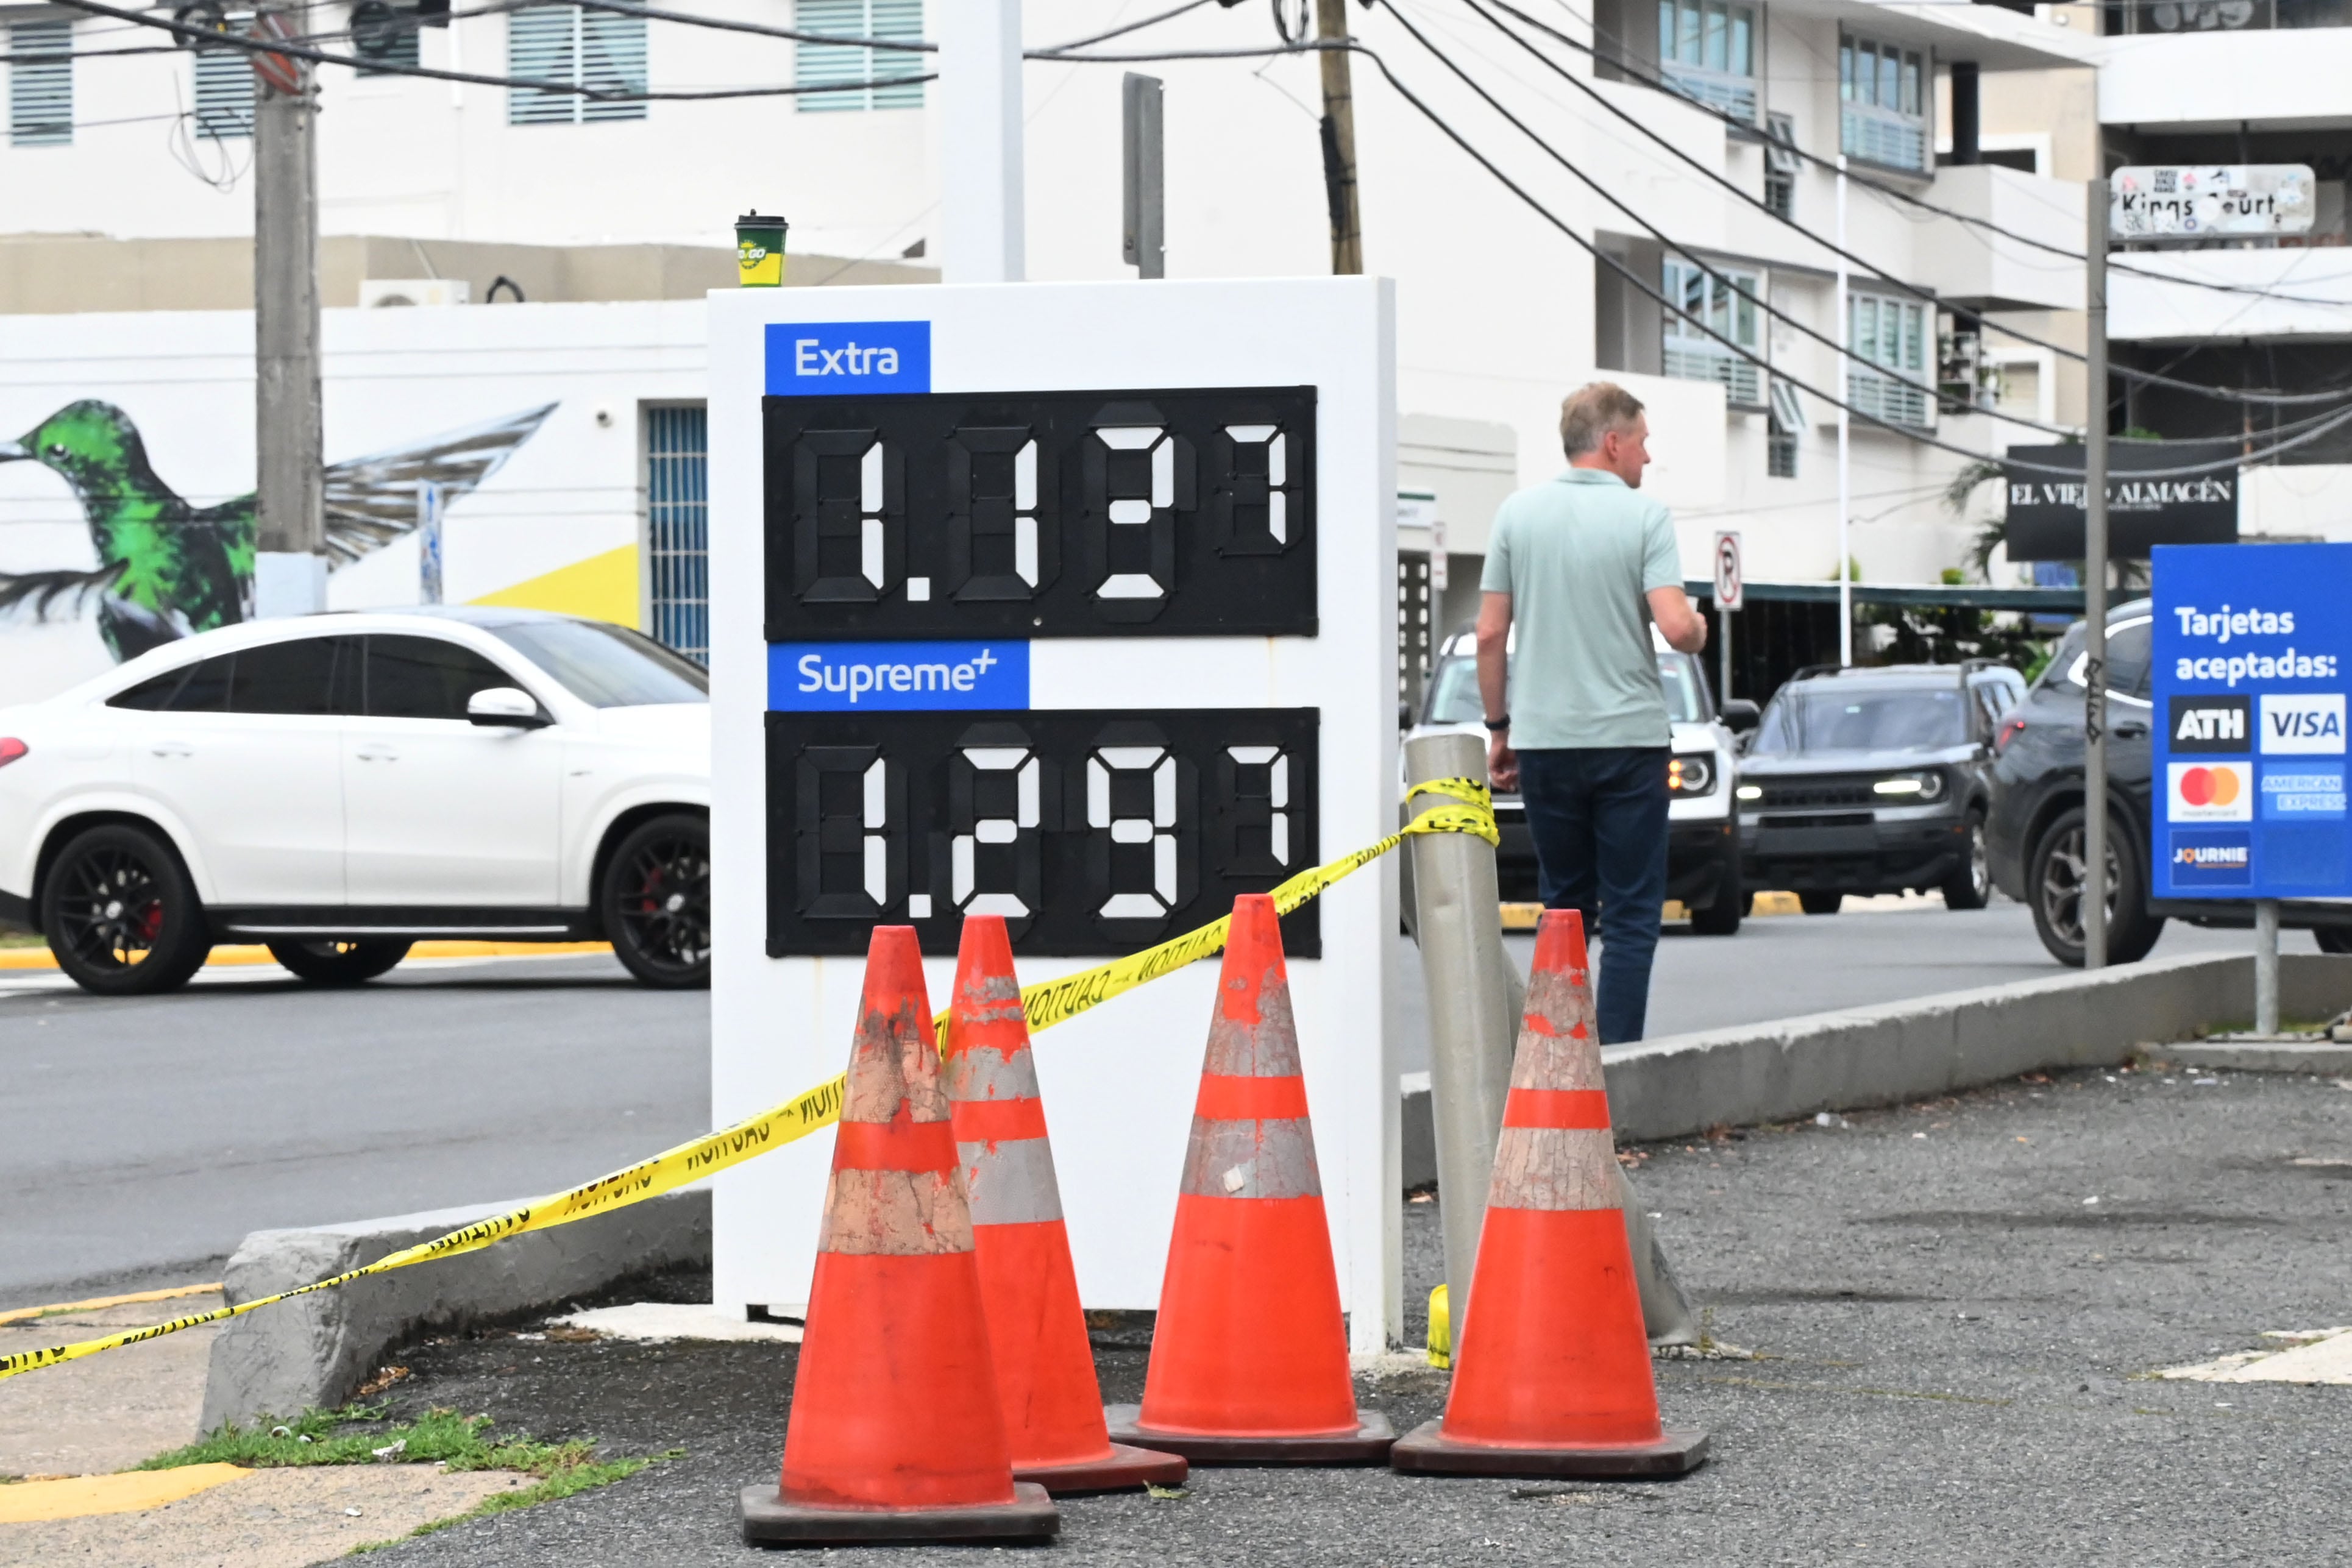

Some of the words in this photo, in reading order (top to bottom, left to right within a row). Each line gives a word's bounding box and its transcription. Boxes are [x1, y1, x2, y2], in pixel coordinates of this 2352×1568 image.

[796, 339, 898, 375] Extra
[2011, 483, 2041, 505] EL
[2043, 483, 2111, 509] VIEJ
[2115, 476, 2231, 503] ALMACÉN
[2174, 605, 2295, 644] Tarjetas
[2176, 647, 2337, 687] aceptadas:
[2176, 709, 2244, 740] ATH
[2270, 711, 2340, 737] VISA
[2261, 775, 2342, 792] AMERICAN
[864, 747, 1289, 918] 1.297
[2173, 846, 2248, 864] JOURNIE
